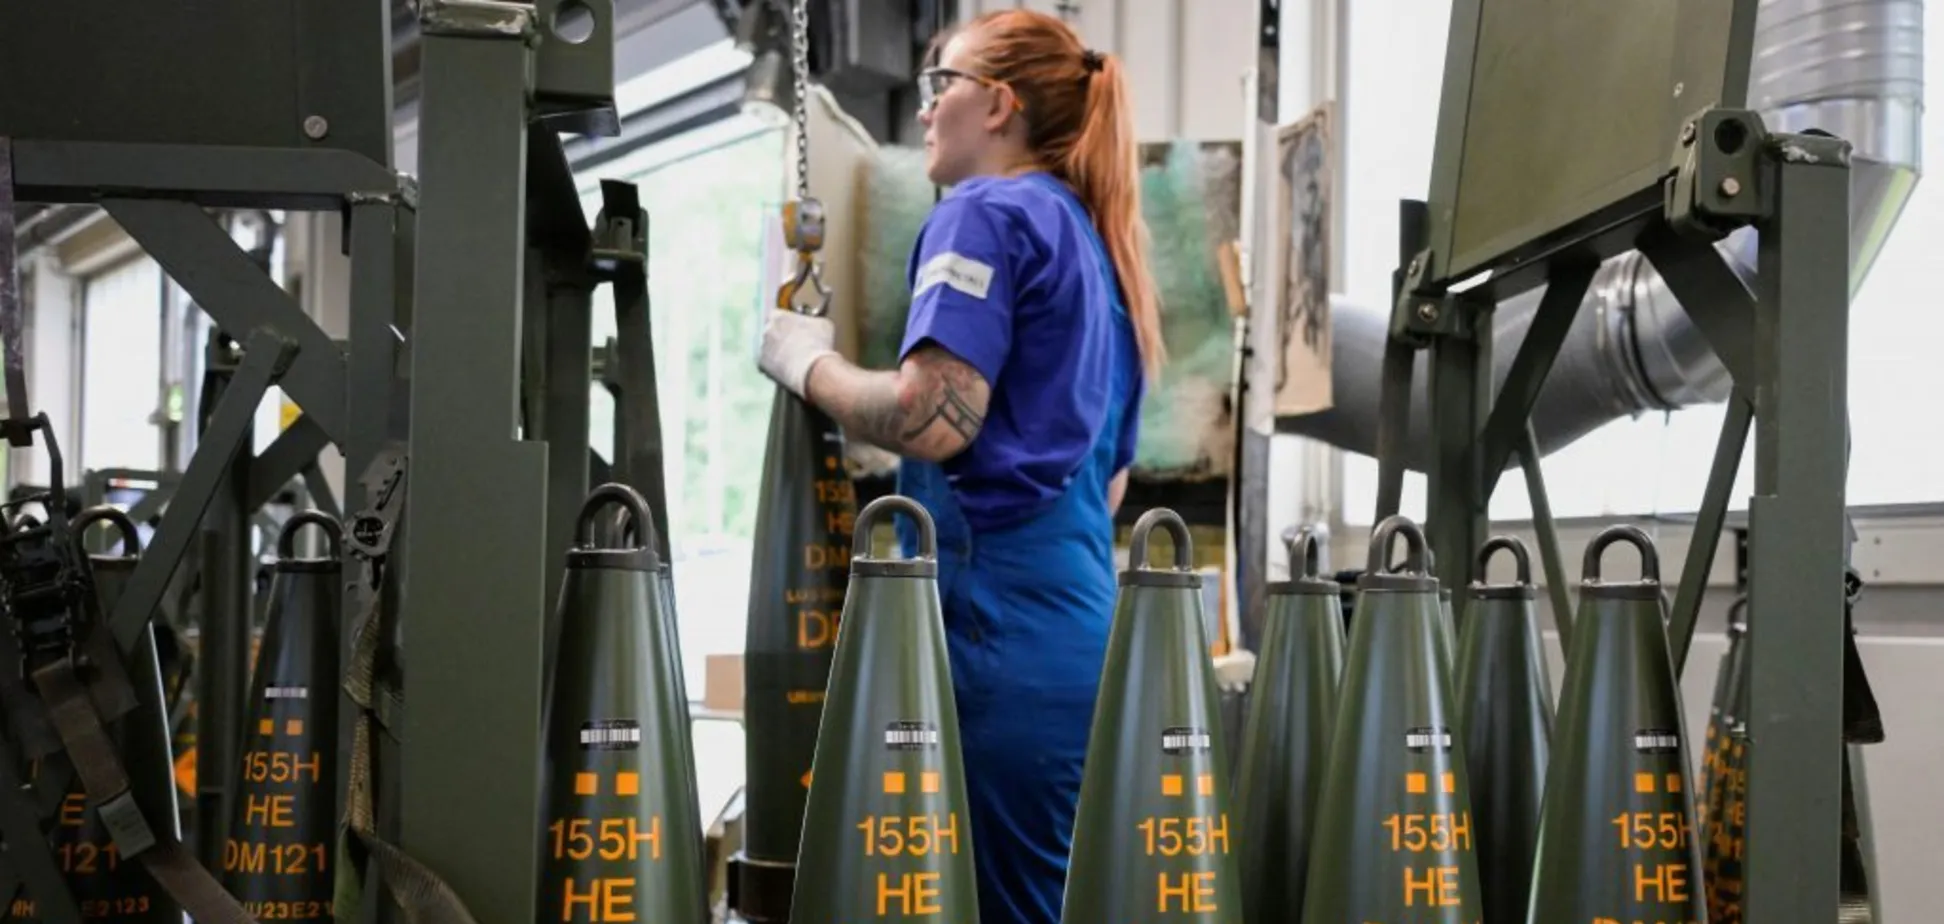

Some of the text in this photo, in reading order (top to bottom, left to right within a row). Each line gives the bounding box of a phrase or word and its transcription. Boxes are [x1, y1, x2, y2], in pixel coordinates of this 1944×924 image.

[243, 752, 320, 783] 155H
[60, 793, 87, 826] E
[246, 794, 293, 827] HE
[1611, 811, 1690, 849] 155H
[549, 815, 661, 860] 155H
[857, 812, 958, 856] 155H
[1137, 813, 1230, 856] 155H
[1382, 811, 1471, 852] 155H
[59, 840, 119, 873] 121
[225, 841, 324, 874] DM121
[562, 875, 638, 923] HE
[876, 871, 941, 917] HE
[1156, 871, 1217, 913] HE
[1403, 866, 1460, 907] HE
[1634, 864, 1688, 902] HE
